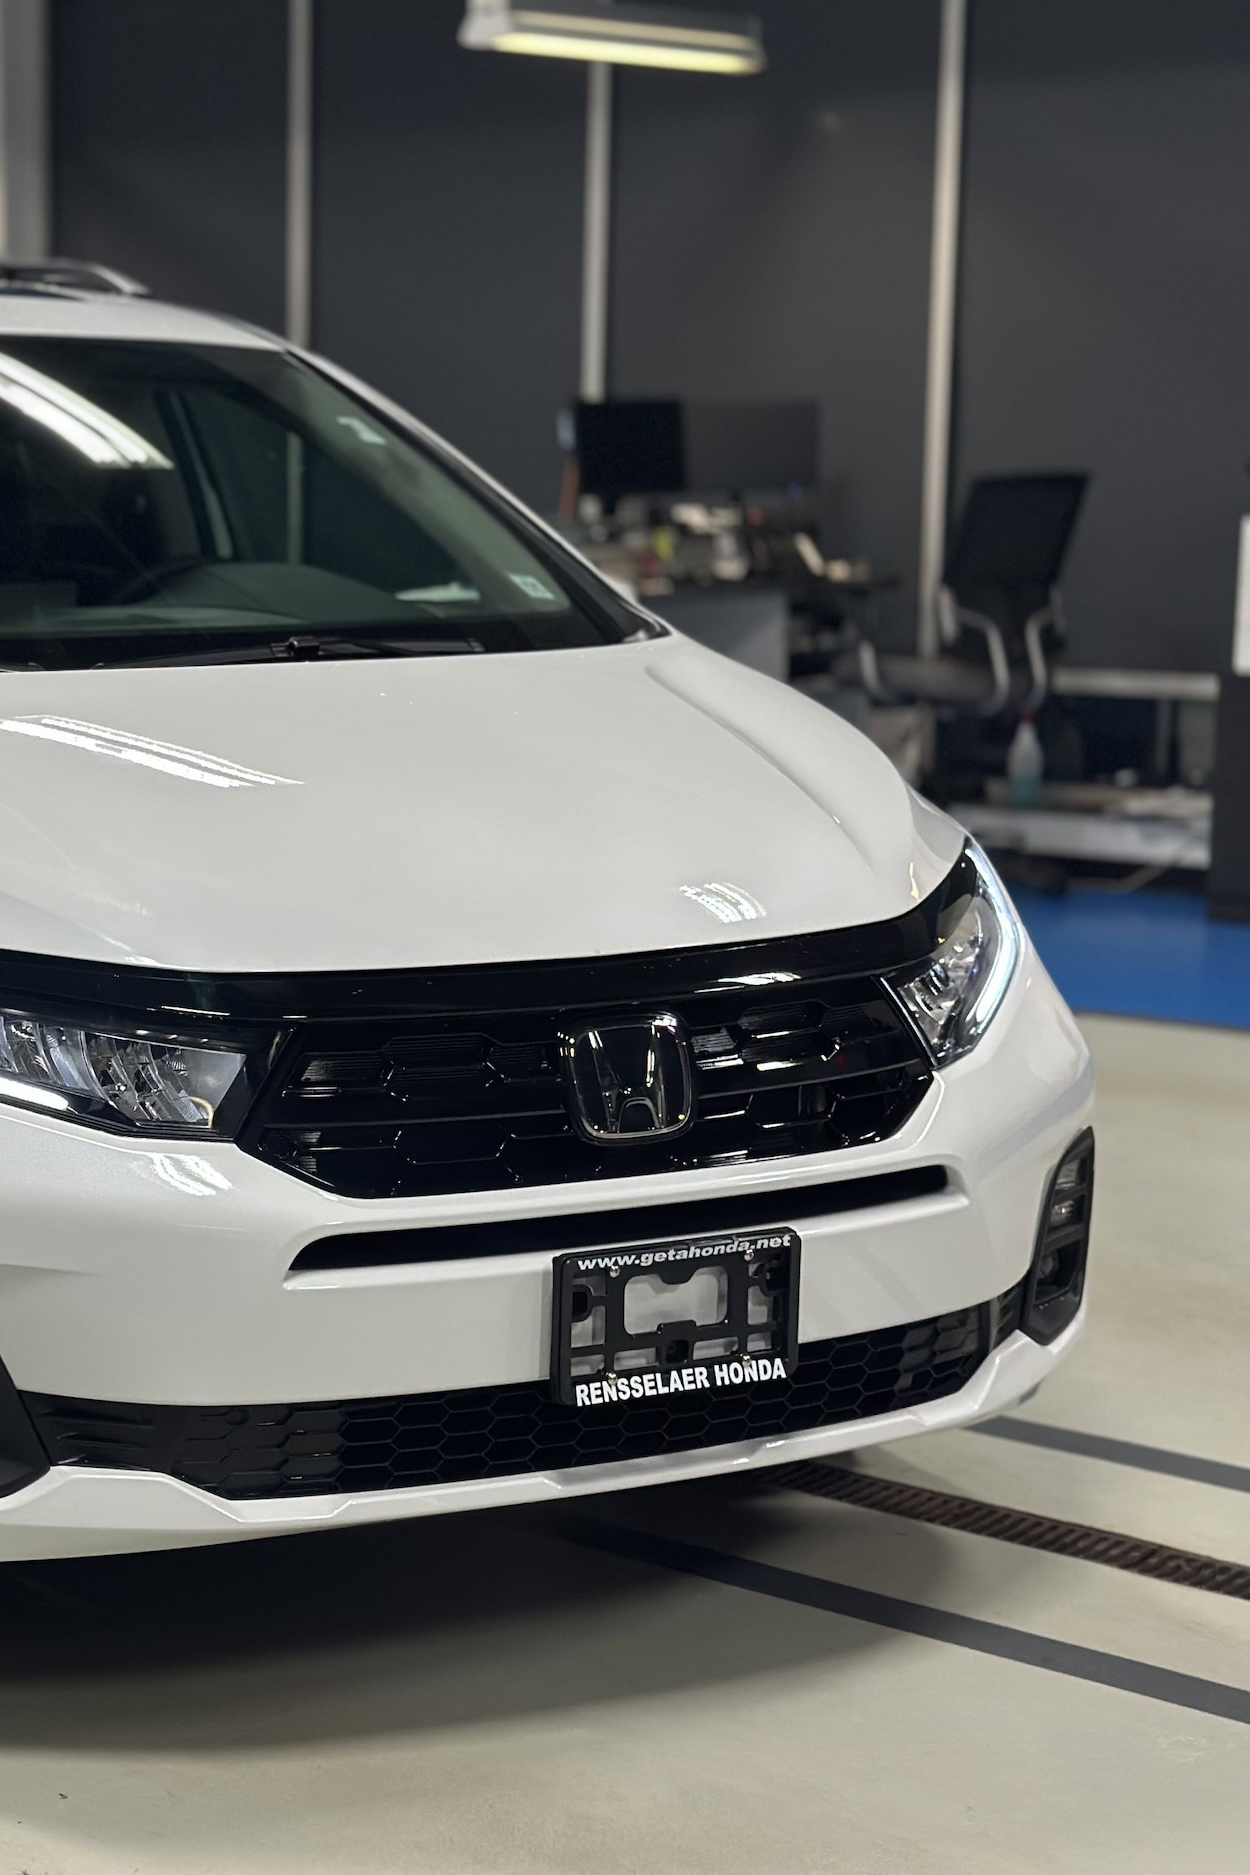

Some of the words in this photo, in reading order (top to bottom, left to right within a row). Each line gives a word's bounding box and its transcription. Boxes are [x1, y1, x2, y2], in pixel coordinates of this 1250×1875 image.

[577, 1233, 792, 1271] www.getahonda.net
[575, 1366, 711, 1407] RENSSELAER
[714, 1357, 787, 1385] HONDA
